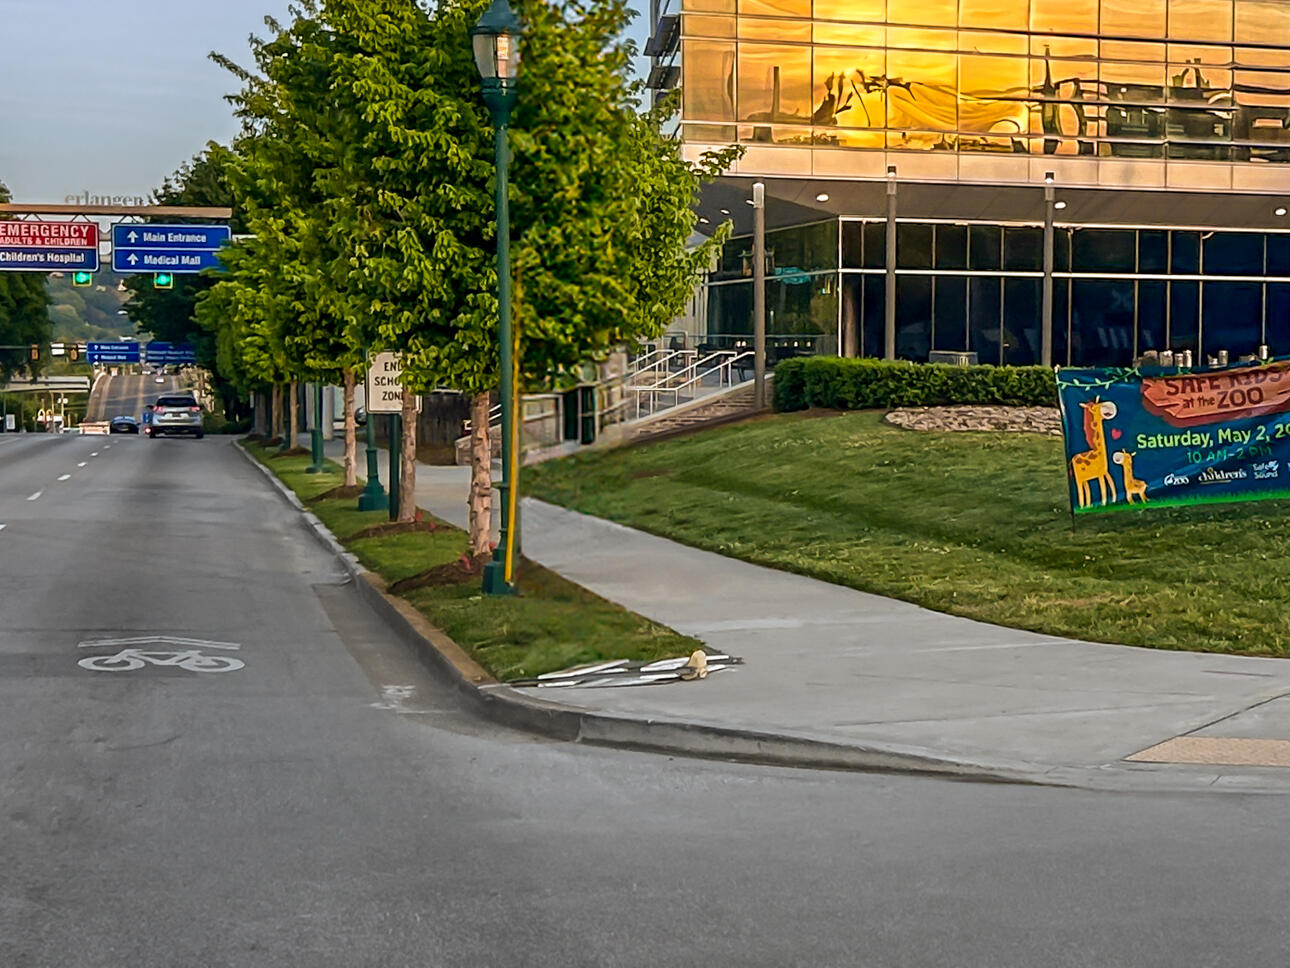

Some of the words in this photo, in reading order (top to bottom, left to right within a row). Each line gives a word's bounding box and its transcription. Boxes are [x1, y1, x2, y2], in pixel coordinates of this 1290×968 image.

[0, 224, 89, 238] EMERGENCY
[143, 232, 166, 242] Main
[168, 233, 207, 243] Entrance
[44, 238, 88, 246] CHILDREN
[0, 252, 45, 263] Children's
[46, 253, 85, 264] Hospital
[144, 255, 179, 265] Medical
[181, 256, 201, 265] Mall
[1166, 376, 1221, 396] SAFE
[1183, 396, 1195, 409] at
[1197, 395, 1215, 407] the
[1216, 386, 1264, 409] ZOO
[1136, 430, 1214, 449] Saturday,
[1218, 428, 1251, 444] May
[1255, 425, 1270, 442] 2,
[1187, 450, 1201, 464] 10
